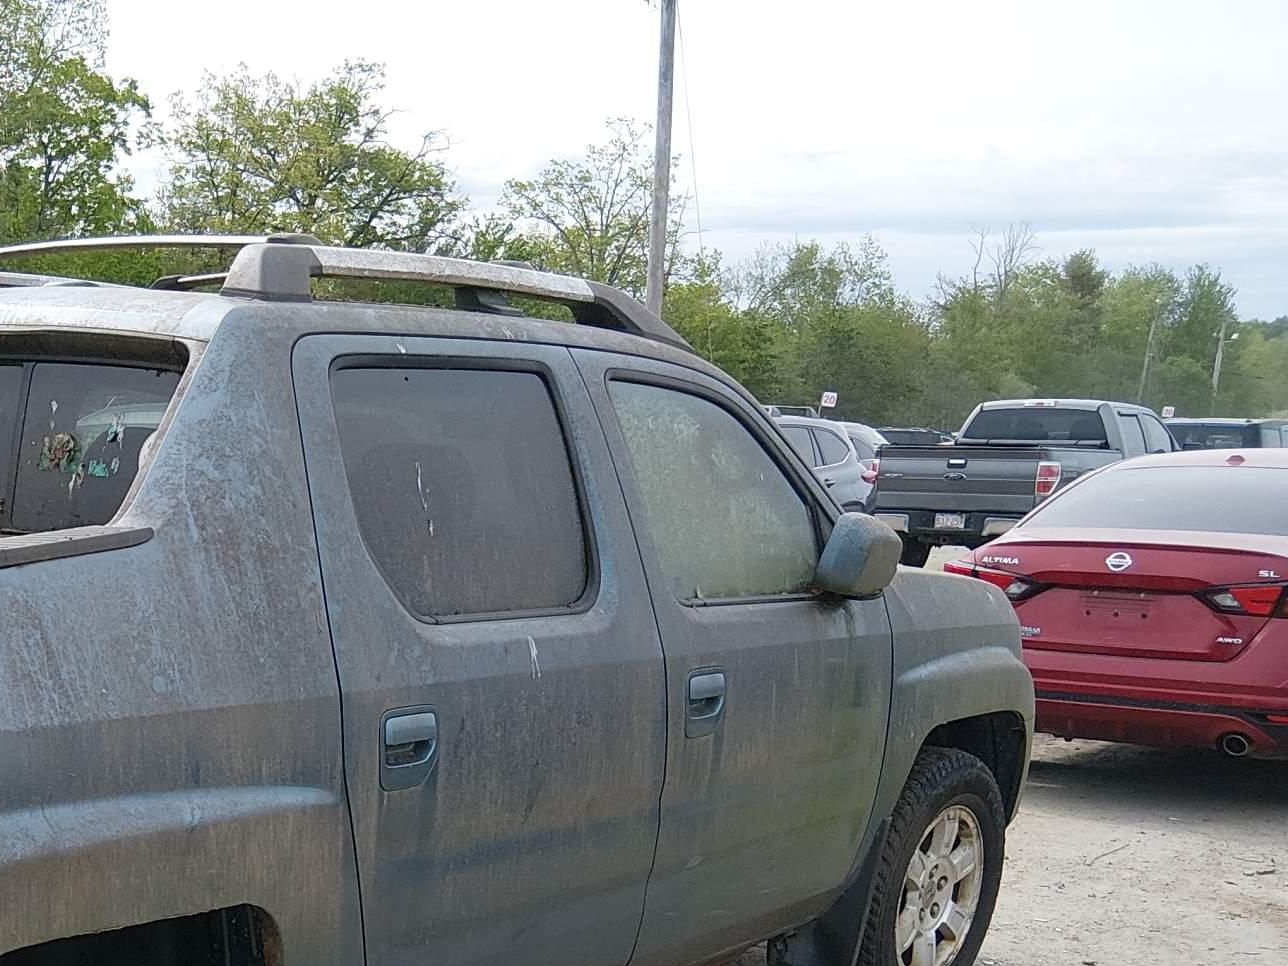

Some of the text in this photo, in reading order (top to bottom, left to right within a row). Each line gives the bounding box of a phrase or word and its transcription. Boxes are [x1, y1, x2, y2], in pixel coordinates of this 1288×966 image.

[823, 395, 835, 405] 20
[982, 556, 1019, 564] ALTIMA
[1258, 570, 1281, 578] SL
[1216, 636, 1242, 644] AWD
